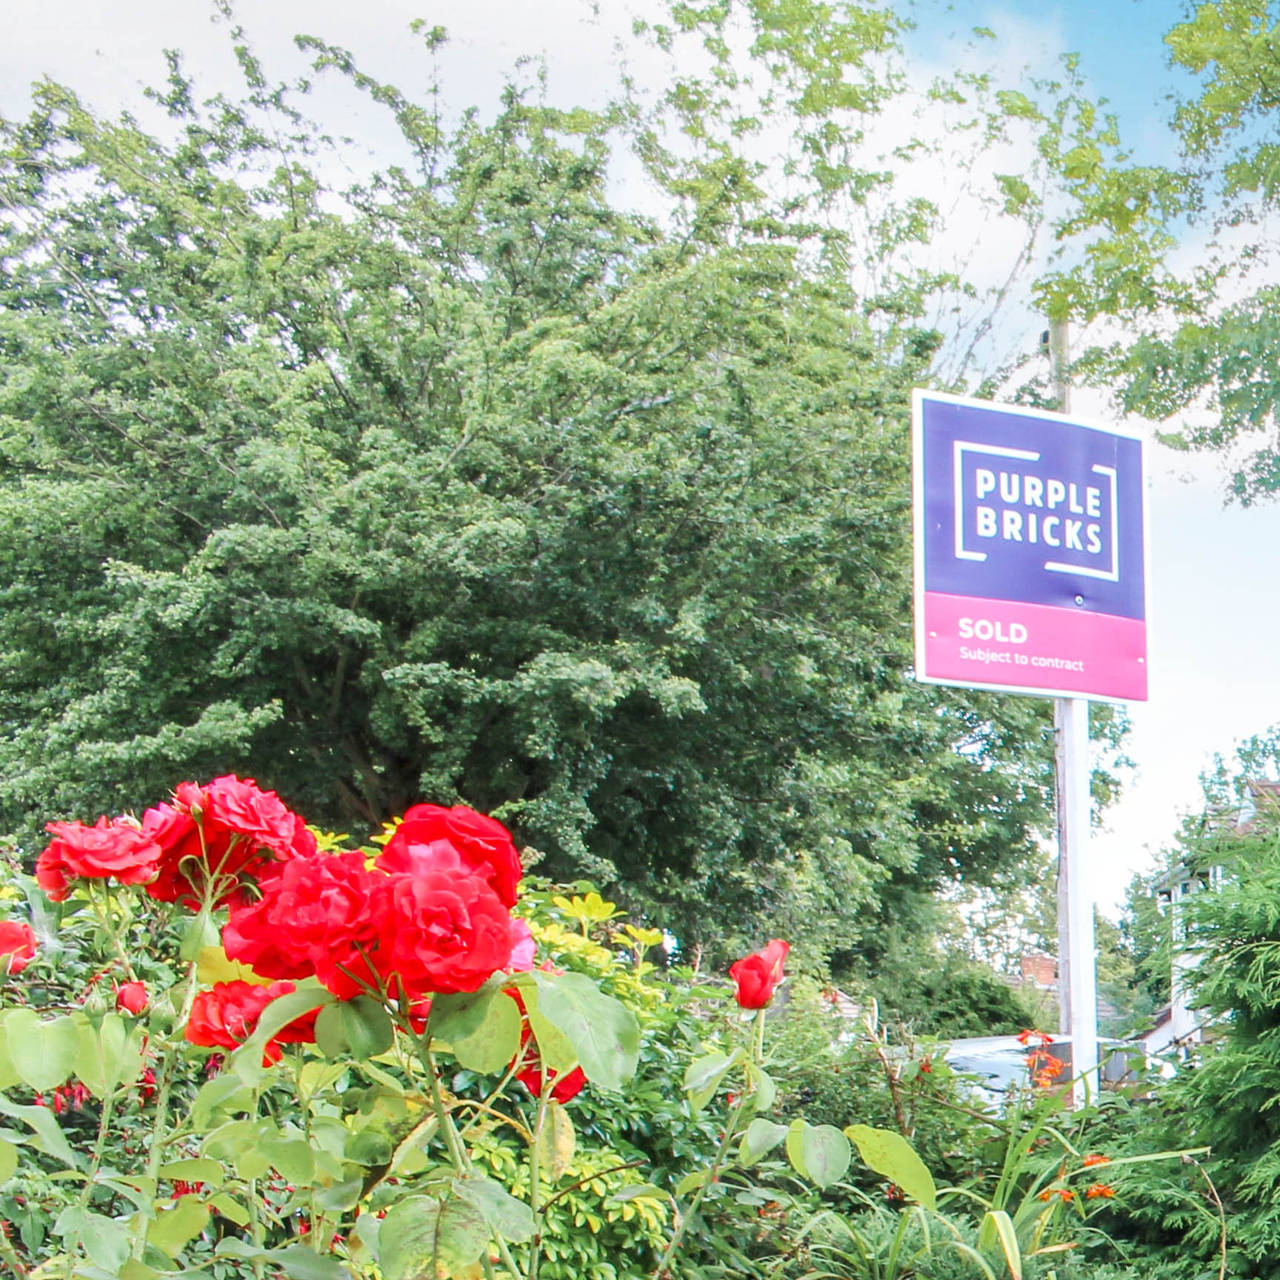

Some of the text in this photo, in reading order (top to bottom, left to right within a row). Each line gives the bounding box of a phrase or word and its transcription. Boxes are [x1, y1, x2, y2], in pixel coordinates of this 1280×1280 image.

[975, 468, 1101, 518] PURPLE
[975, 506, 1102, 554] BRICKS
[958, 617, 1028, 644] SOLD
[959, 646, 1085, 672] Subject to contract
